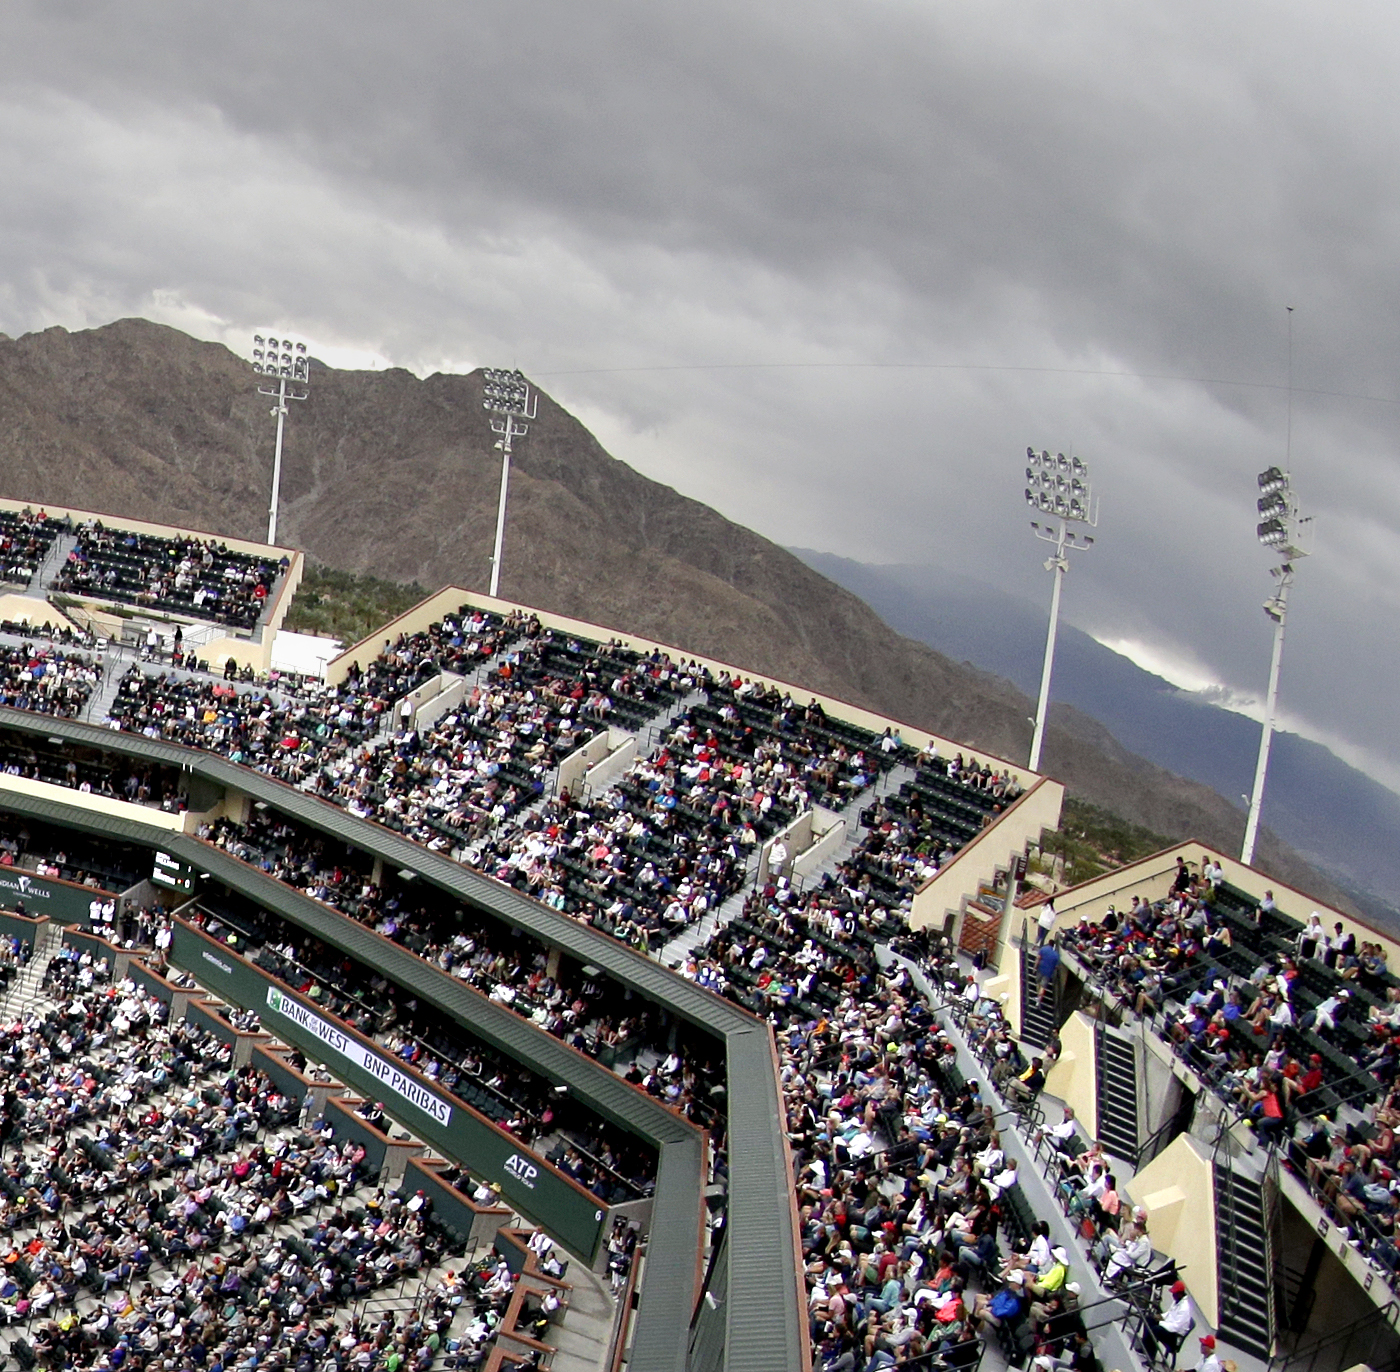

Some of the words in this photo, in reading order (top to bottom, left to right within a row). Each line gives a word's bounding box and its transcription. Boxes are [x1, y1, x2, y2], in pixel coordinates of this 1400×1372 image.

[27, 886, 50, 898] WELLS
[281, 998, 310, 1026] BANK
[319, 1023, 350, 1053] WEST
[363, 1052, 390, 1078] BNP
[391, 1075, 447, 1122] PARIBAS
[505, 1153, 538, 1179] ATP
[594, 1210, 602, 1221] 6
